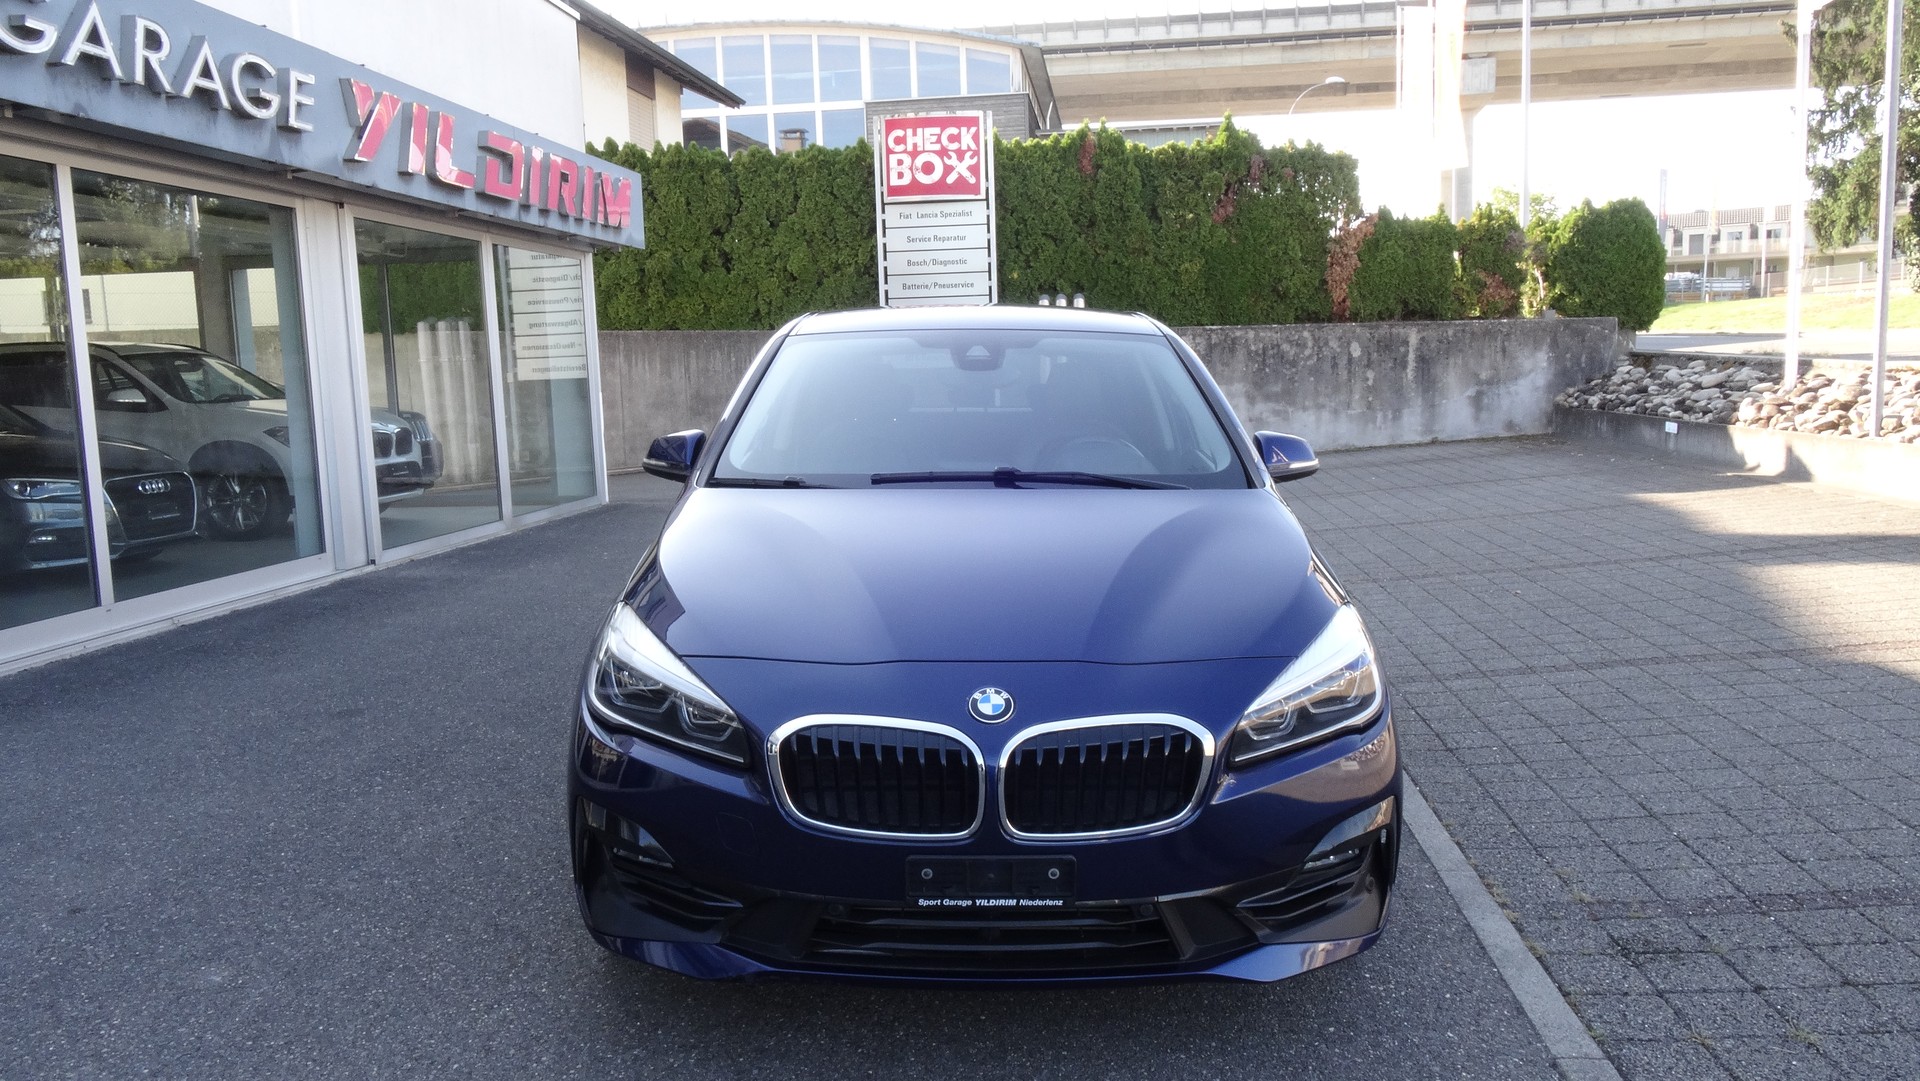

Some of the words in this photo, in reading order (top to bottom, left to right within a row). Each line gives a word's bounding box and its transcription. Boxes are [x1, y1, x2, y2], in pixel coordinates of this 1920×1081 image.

[0, 0, 316, 132] GARAGE
[339, 78, 632, 228] YILDIRIM
[887, 126, 978, 152] CHECK
[899, 212, 912, 220] Fiat
[916, 211, 938, 219] Lancia
[940, 210, 973, 219] Spezialist
[906, 235, 932, 243] Service
[933, 235, 967, 243] Reparatur
[907, 258, 968, 267] Bosch/Diagnostic
[902, 281, 975, 290] Batterie/Pneuservice
[973, 688, 1009, 699] BMW
[918, 898, 941, 907] Sport
[943, 898, 972, 907] Garage
[1019, 898, 1064, 906] Niederlenz
